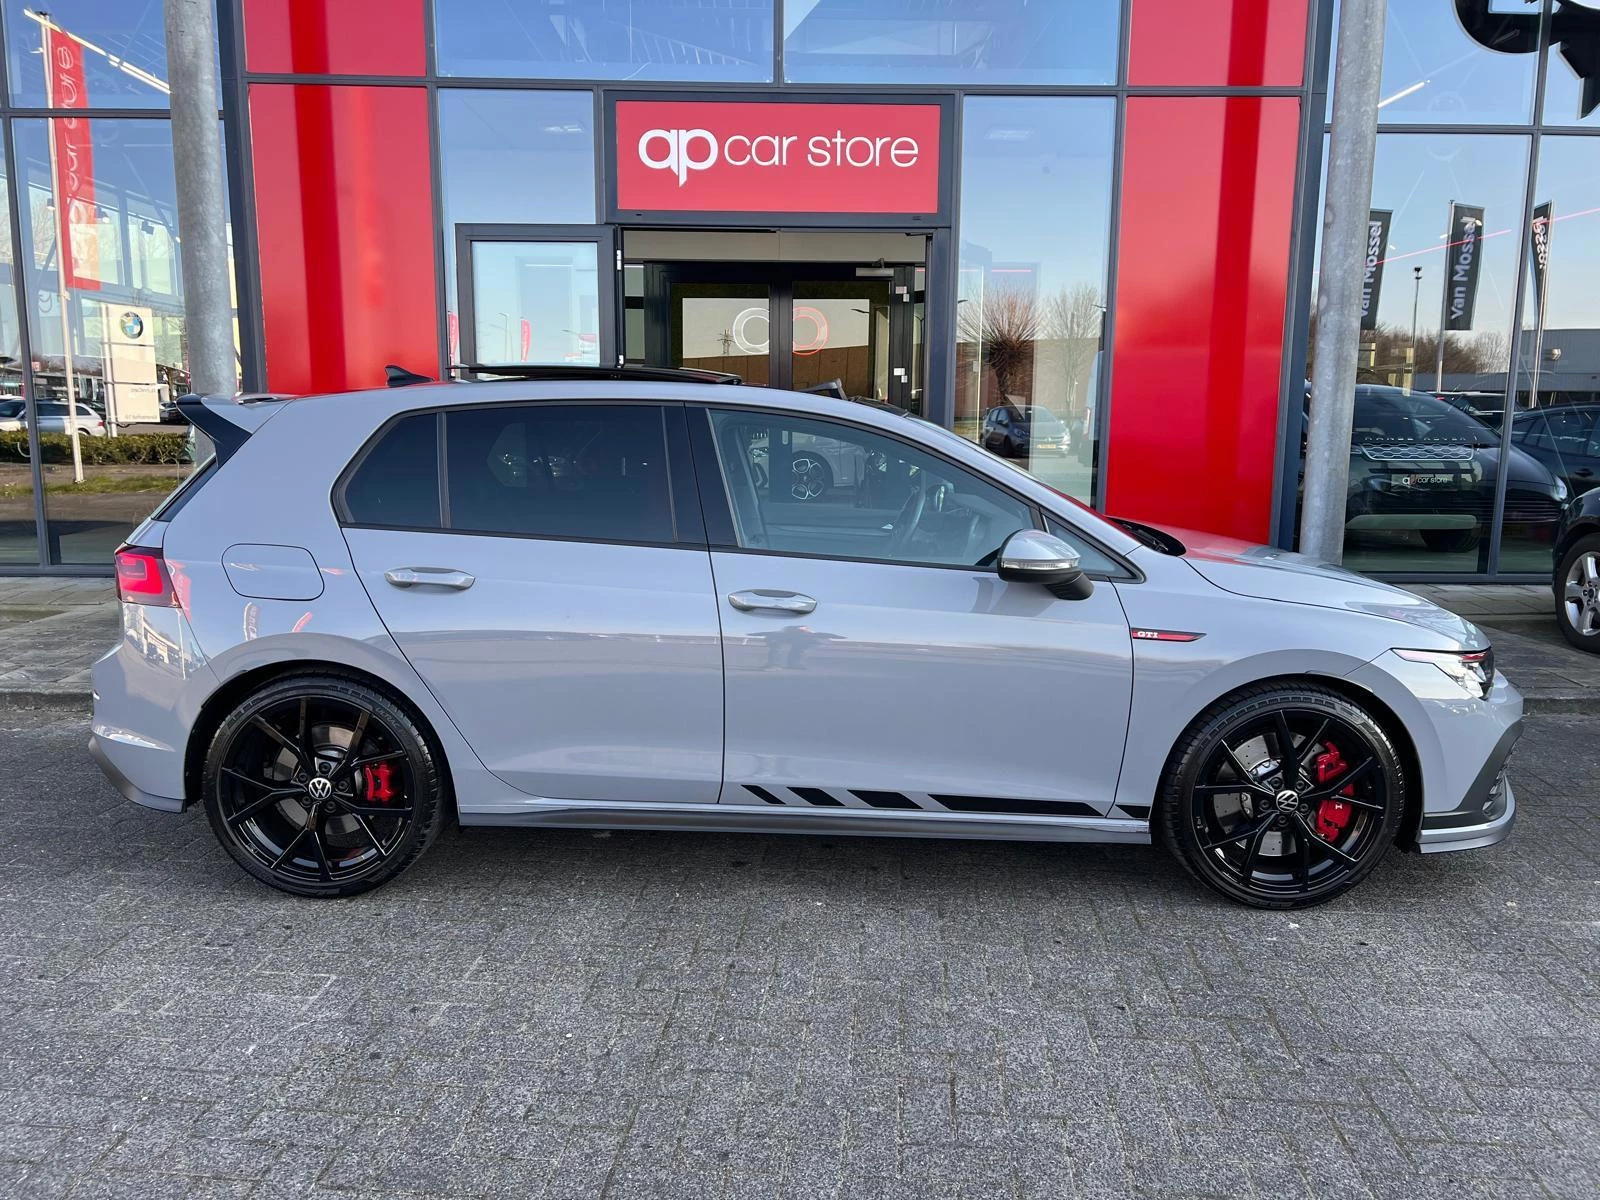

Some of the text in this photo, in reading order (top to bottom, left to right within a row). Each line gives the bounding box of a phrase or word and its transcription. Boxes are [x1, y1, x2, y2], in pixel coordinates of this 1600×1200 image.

[638, 128, 919, 188] ap car store
[1450, 215, 1477, 320] Van Mossel
